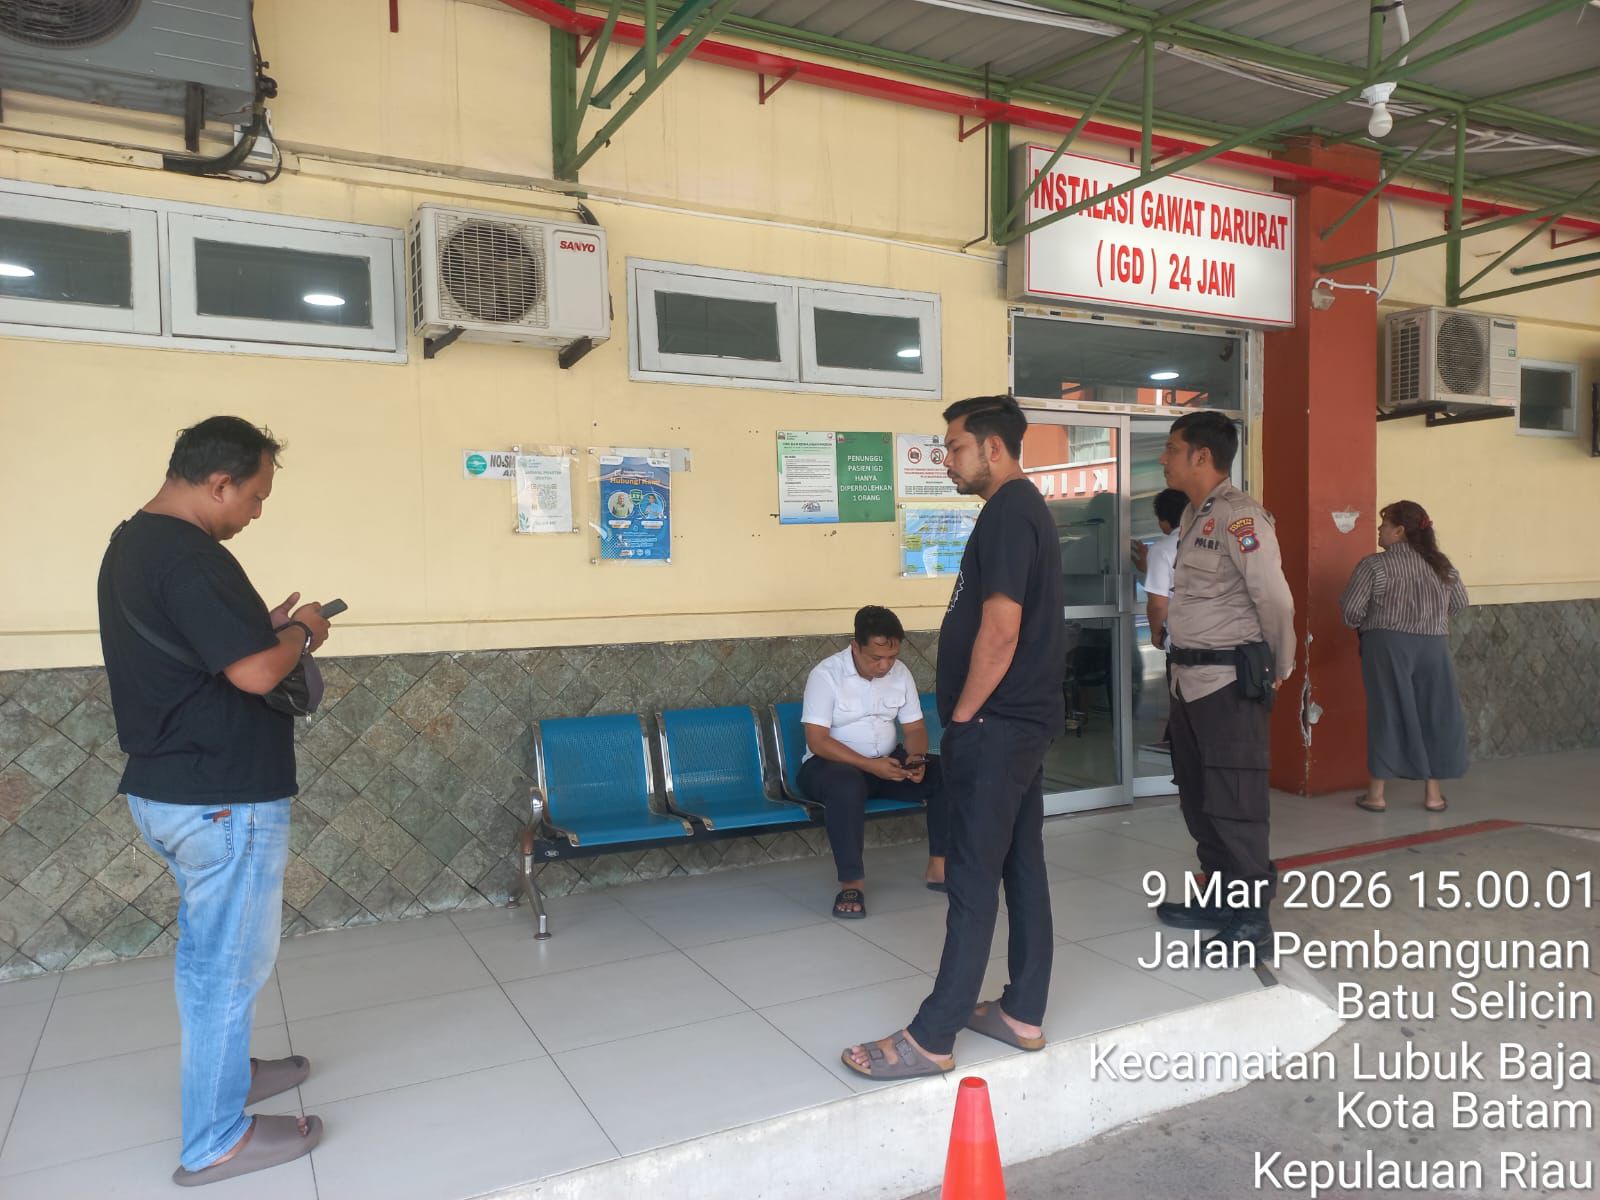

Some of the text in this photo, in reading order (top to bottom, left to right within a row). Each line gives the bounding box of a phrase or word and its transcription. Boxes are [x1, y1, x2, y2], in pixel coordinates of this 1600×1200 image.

[1034, 169, 1288, 251] INSTALASI GAWAT DARURAT
[559, 240, 596, 253] SANYO
[1169, 253, 1191, 293] 24
[1197, 258, 1236, 298] JAM
[840, 484, 892, 492] DIPERBOLEHKAN
